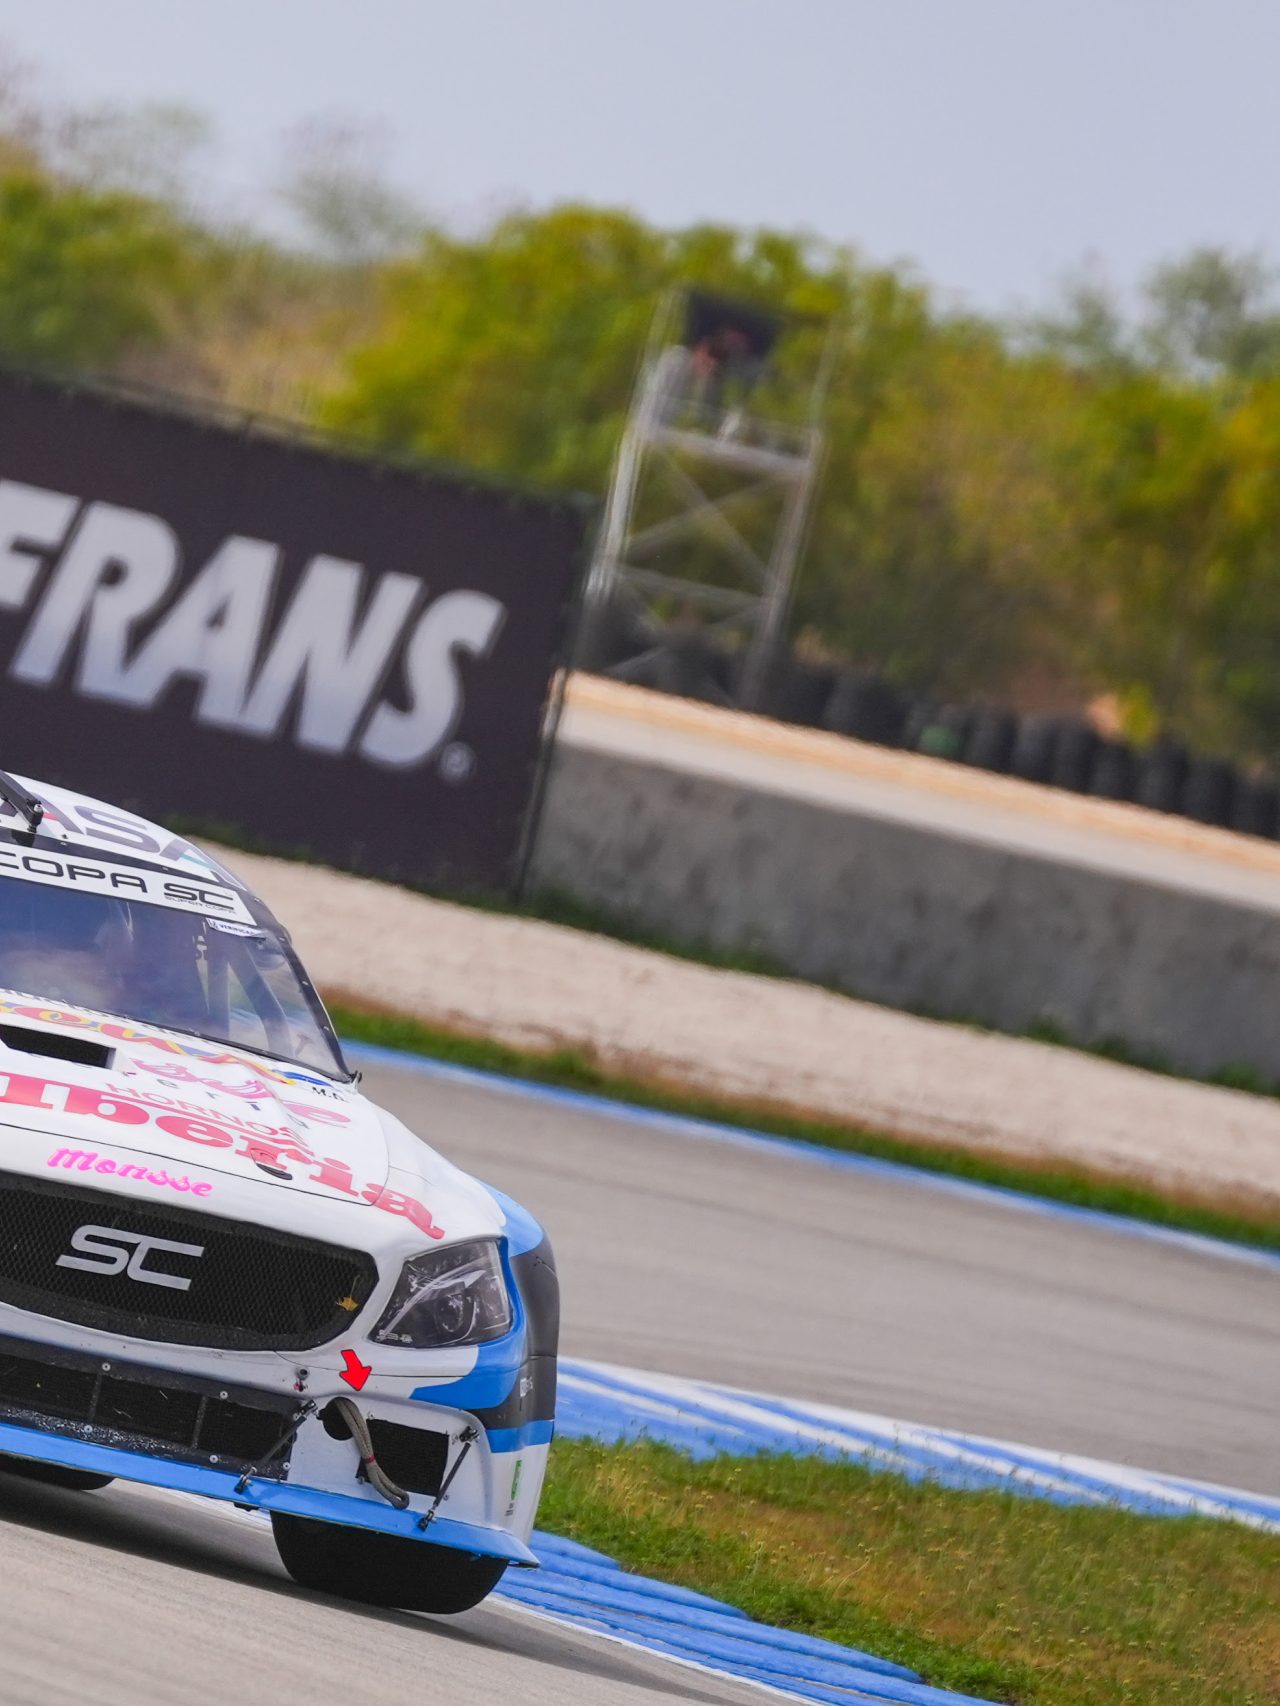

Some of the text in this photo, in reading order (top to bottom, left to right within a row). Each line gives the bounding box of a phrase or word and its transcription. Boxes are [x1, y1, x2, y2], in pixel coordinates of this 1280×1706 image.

[163, 882, 235, 911] SC
[105, 1083, 309, 1148] HORNOS
[47, 1148, 213, 1198] Monsse
[56, 1224, 205, 1292] SC
